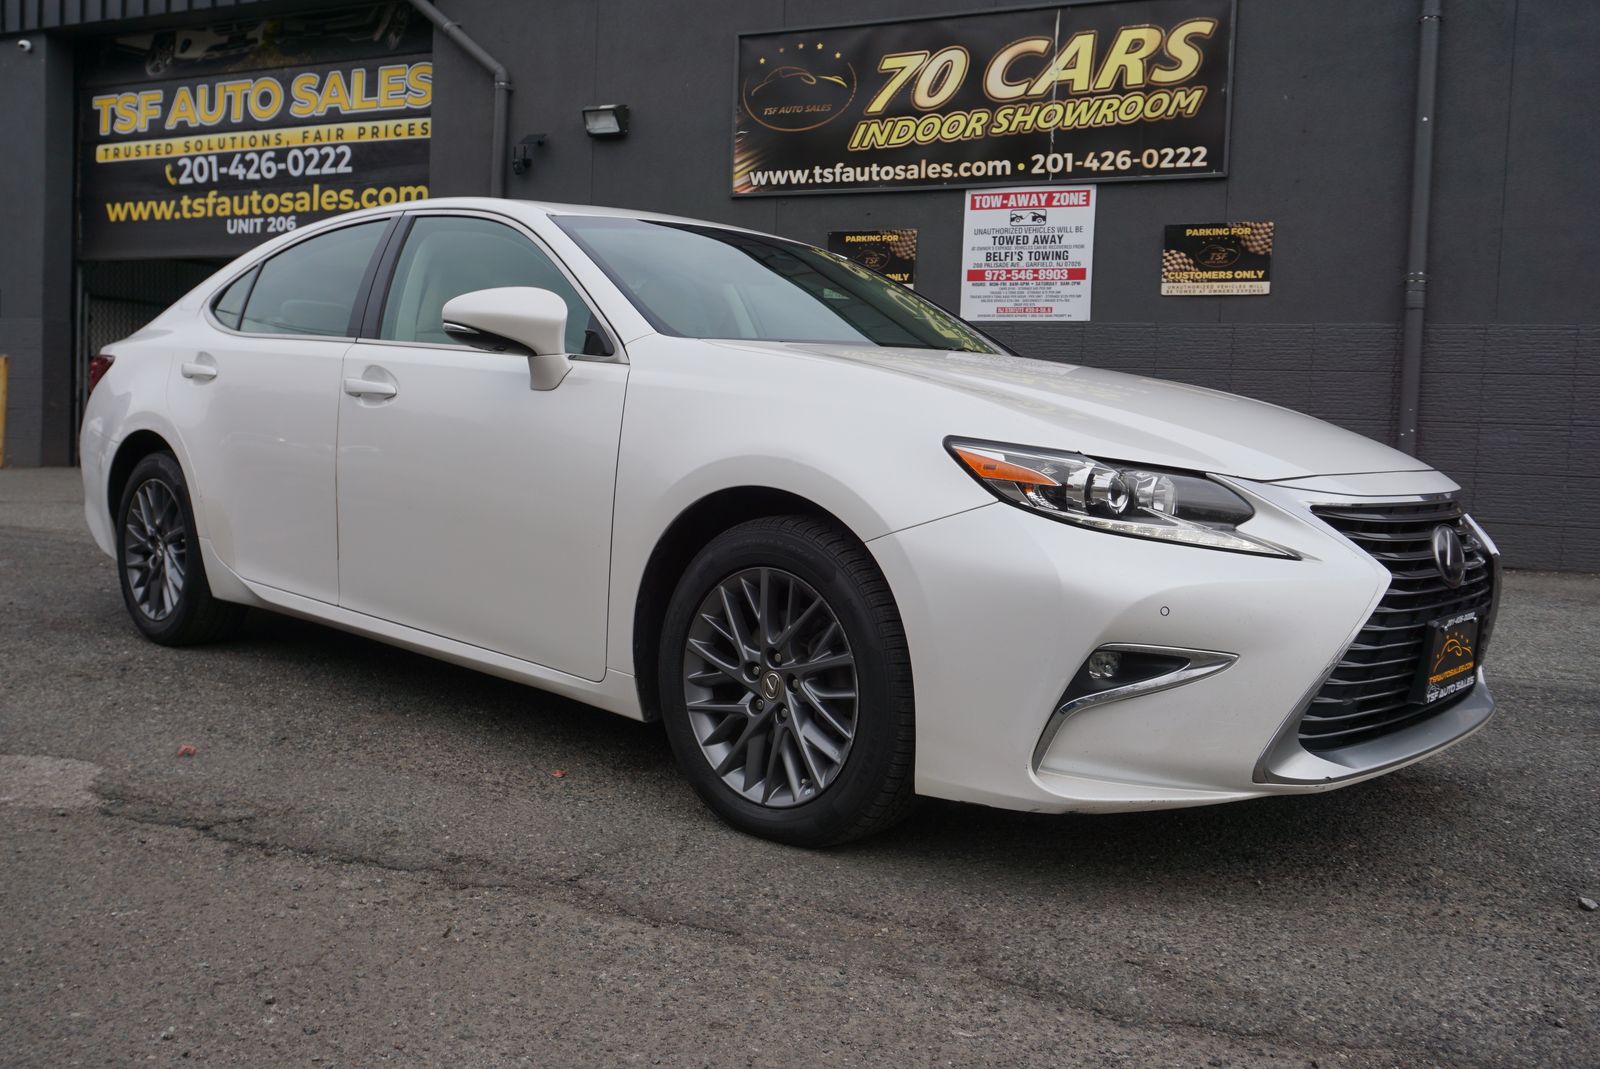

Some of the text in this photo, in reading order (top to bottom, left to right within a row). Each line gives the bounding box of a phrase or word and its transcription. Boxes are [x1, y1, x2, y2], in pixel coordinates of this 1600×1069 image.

[863, 17, 1218, 116] 70 CARS
[92, 62, 433, 136] TSF AUTO SALES
[764, 103, 832, 116] TSF AUTO SALES
[848, 86, 1208, 152] INDOOR SHOWROOM
[102, 121, 431, 160] TRUSTED SOLUTIONS, FAIR PRICES
[177, 145, 353, 186] 201-426-0222
[748, 145, 1208, 186] www.tsfautosales.com 201-426-0222
[105, 183, 429, 223] www.tsfautosales.com
[974, 191, 1087, 209] TOW-AWAY ZONE
[226, 215, 297, 235] UNIT 206
[974, 227, 1023, 236] UNAUTHORIZED
[1186, 227, 1251, 236] PARKING FOR
[992, 234, 1064, 246] TOWED AWAY
[986, 250, 1069, 262] BELFI'S TOWING
[984, 269, 1068, 280] 973-546-8903
[1168, 270, 1264, 280] CUSTOMERS ONLY
[1426, 676, 1475, 703] TSF AUTO SALES
